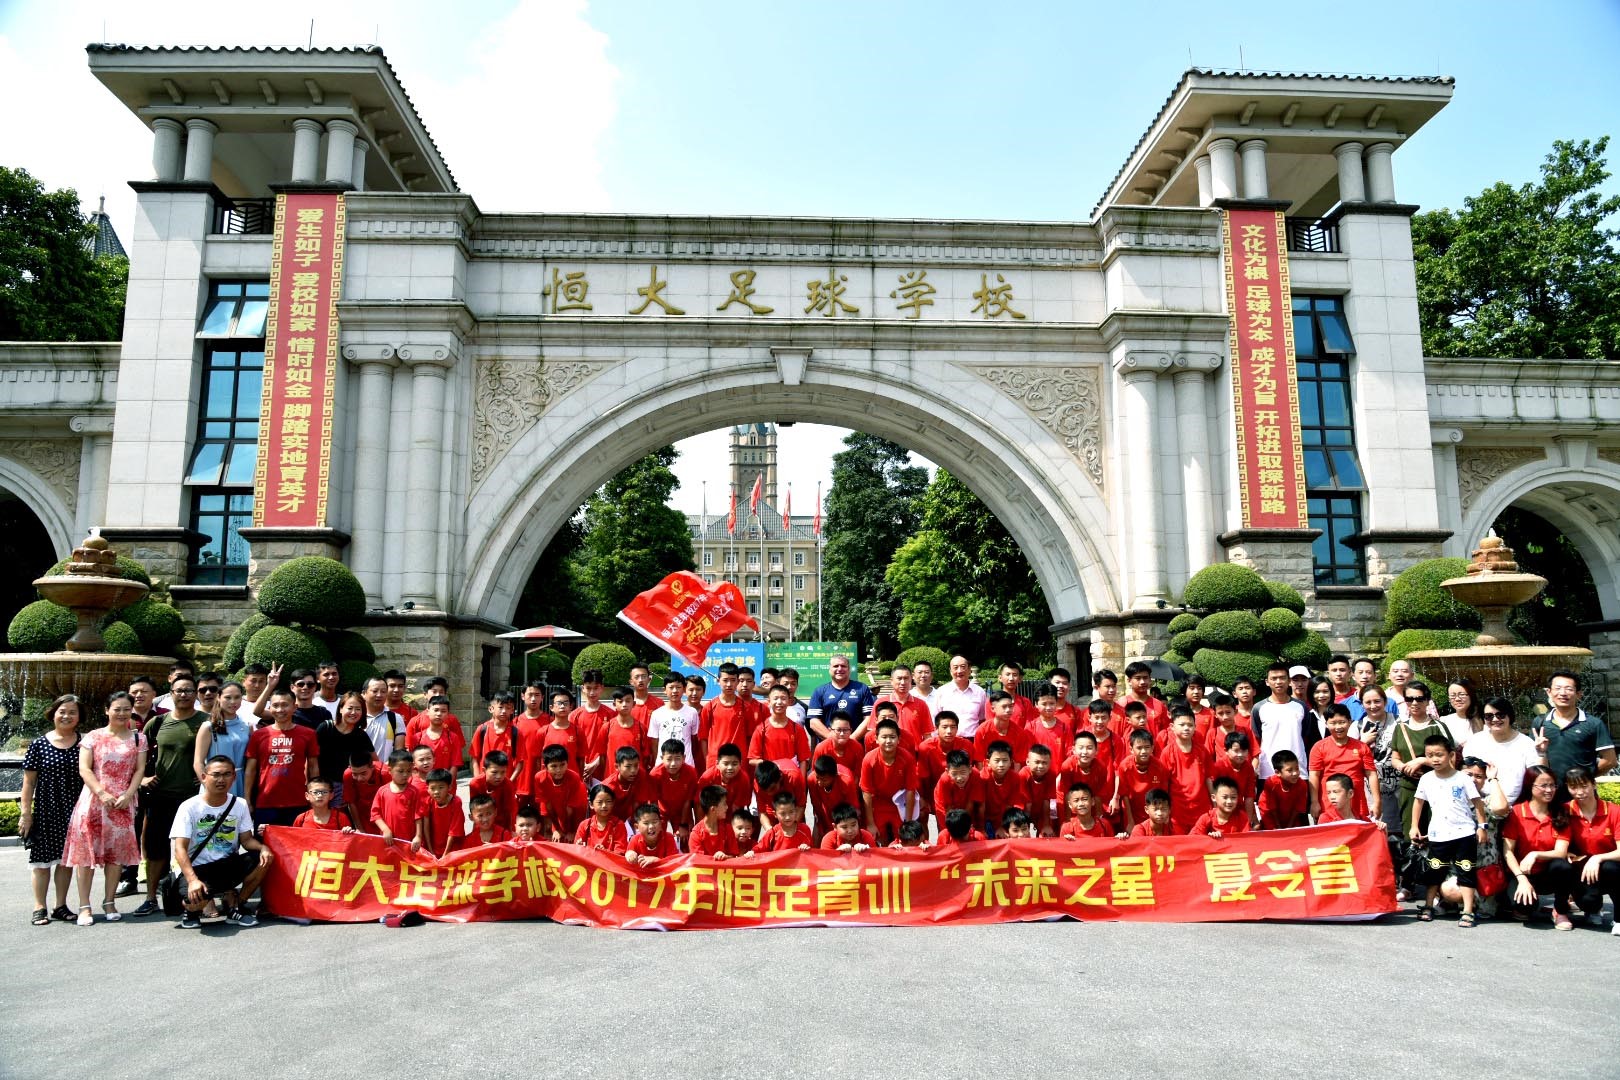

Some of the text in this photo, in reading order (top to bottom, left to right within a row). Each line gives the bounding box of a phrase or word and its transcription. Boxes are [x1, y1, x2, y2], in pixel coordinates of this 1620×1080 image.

[543, 265, 1027, 320] 恒大足球学校
[1245, 285, 1274, 343] 足球为本
[275, 208, 325, 513] 爱生如子 爱校如家 惜时如金 脚踏实地育英才
[1249, 346, 1278, 406] 成才为旨
[1254, 410, 1286, 515] 开拓进取探新路
[271, 737, 293, 747] SPIN
